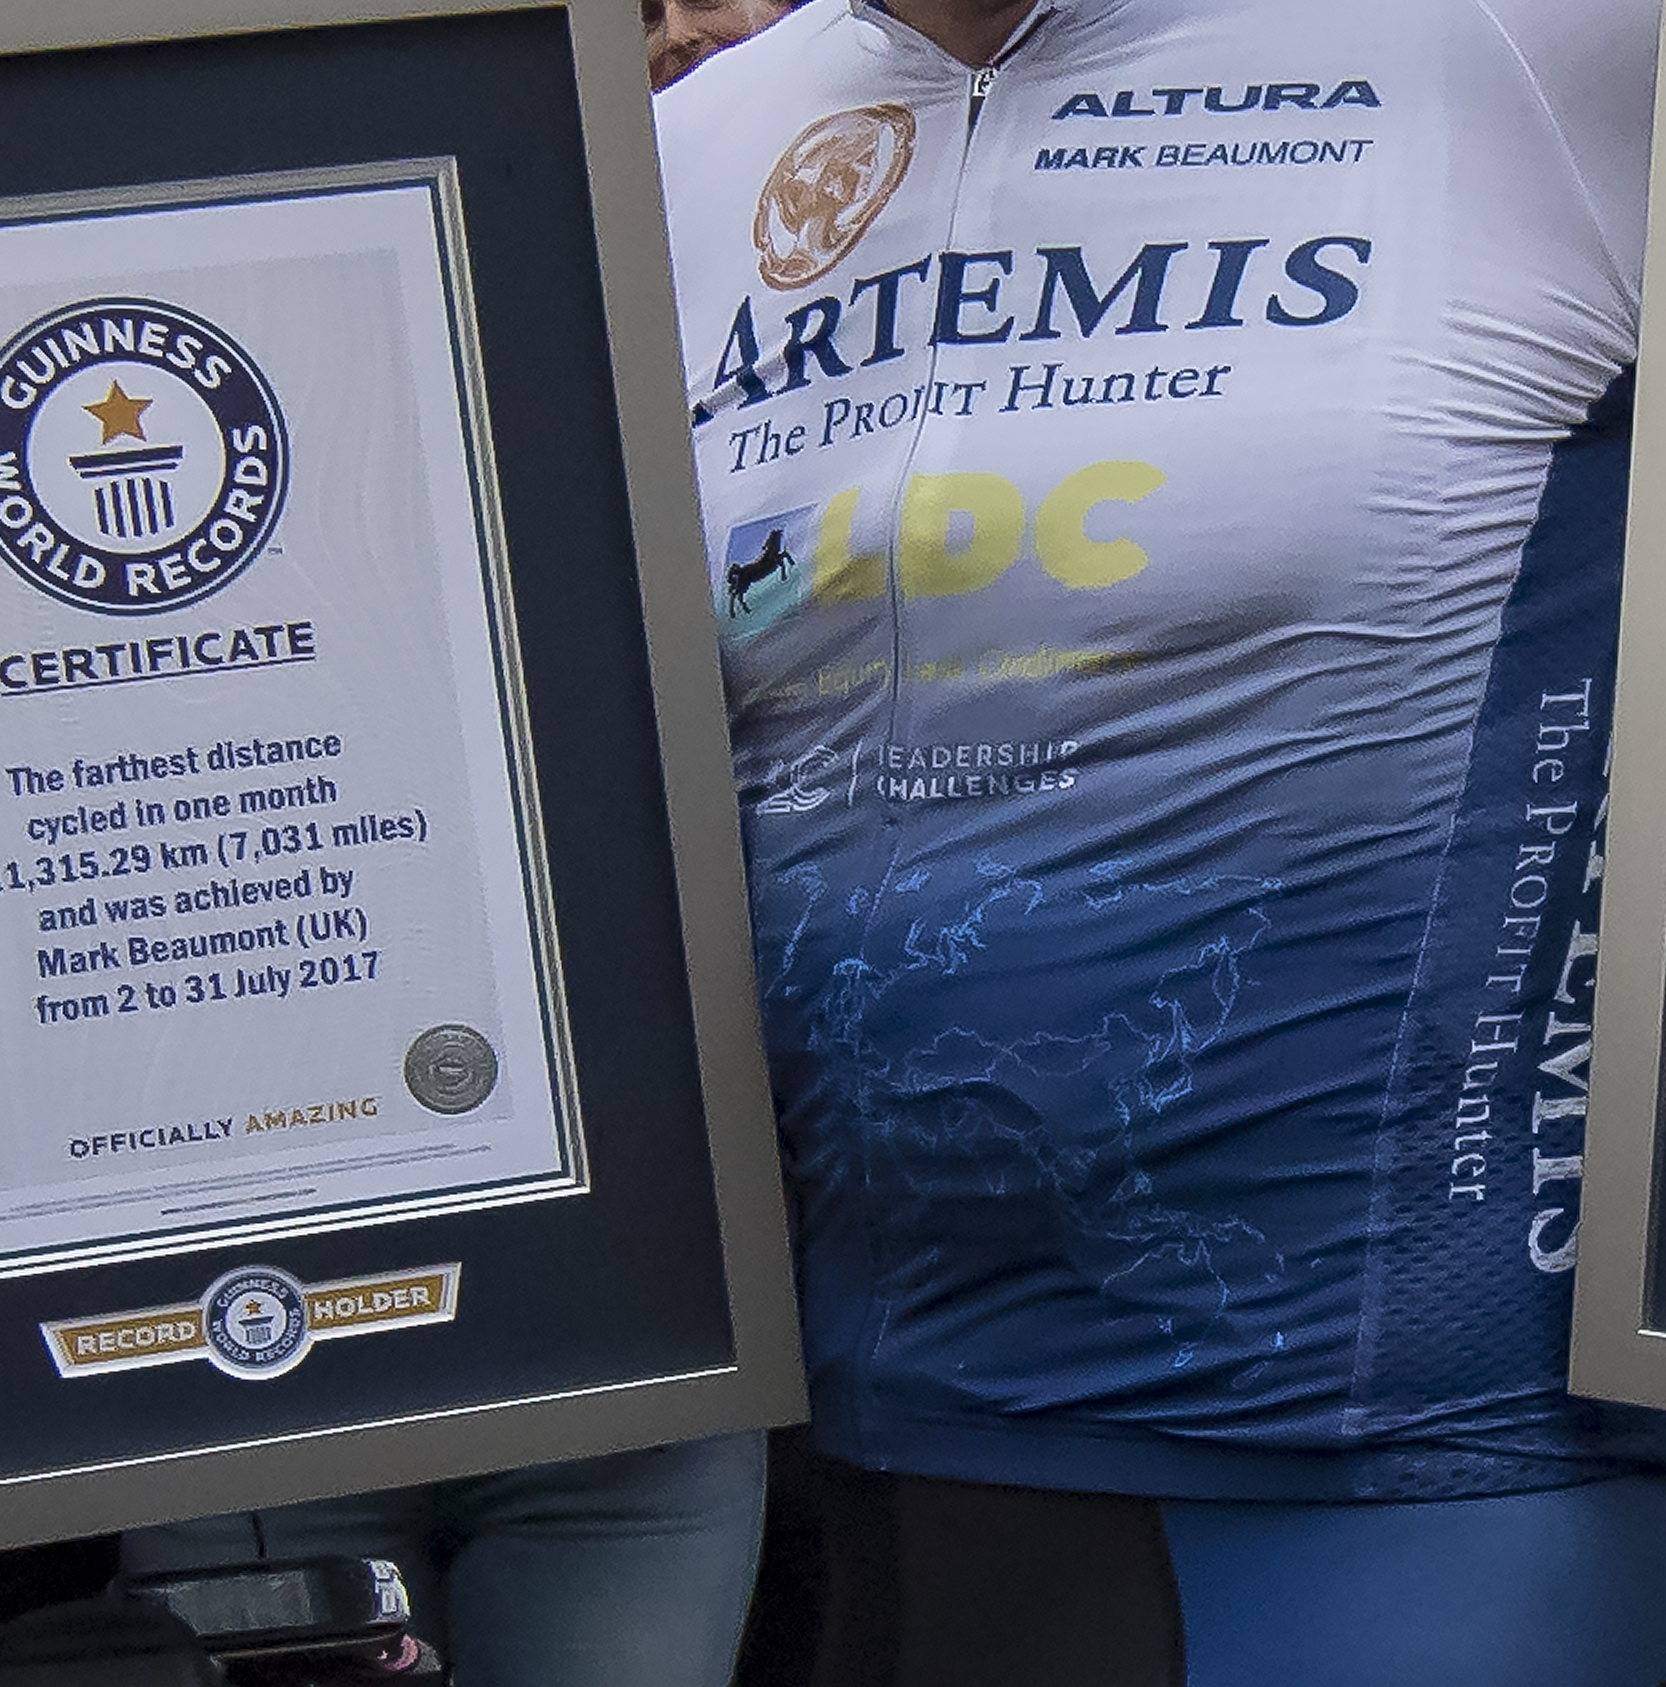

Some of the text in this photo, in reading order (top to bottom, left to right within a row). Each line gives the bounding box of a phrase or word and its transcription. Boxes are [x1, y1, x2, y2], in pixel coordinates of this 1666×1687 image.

[1051, 80, 1382, 120] ALTURA
[1034, 139, 1373, 170] MARK BEAUMONT
[0, 318, 232, 410] GUINNESS
[691, 235, 1373, 427] ARTEMIS
[729, 419, 805, 473] The
[1000, 361, 1232, 413] Hunter
[126, 424, 269, 597] RECORDS
[813, 459, 1167, 607] LDC
[7, 733, 342, 796] The farthest distance
[27, 775, 337, 845] cycled in one month
[161, 840, 208, 869] km
[217, 822, 323, 868] (7,031
[332, 809, 428, 847] miles)
[38, 866, 354, 932] and was achieved by
[37, 908, 369, 978] Mark Beaumont (UK)
[1448, 677, 1593, 1202] The PROFIT Hunter
[35, 950, 380, 1023] from 2 to 31 July 2017
[69, 1096, 380, 1158] OFFICIALLY AMAZING
[76, 1286, 432, 1354] RECORD HOLDER
